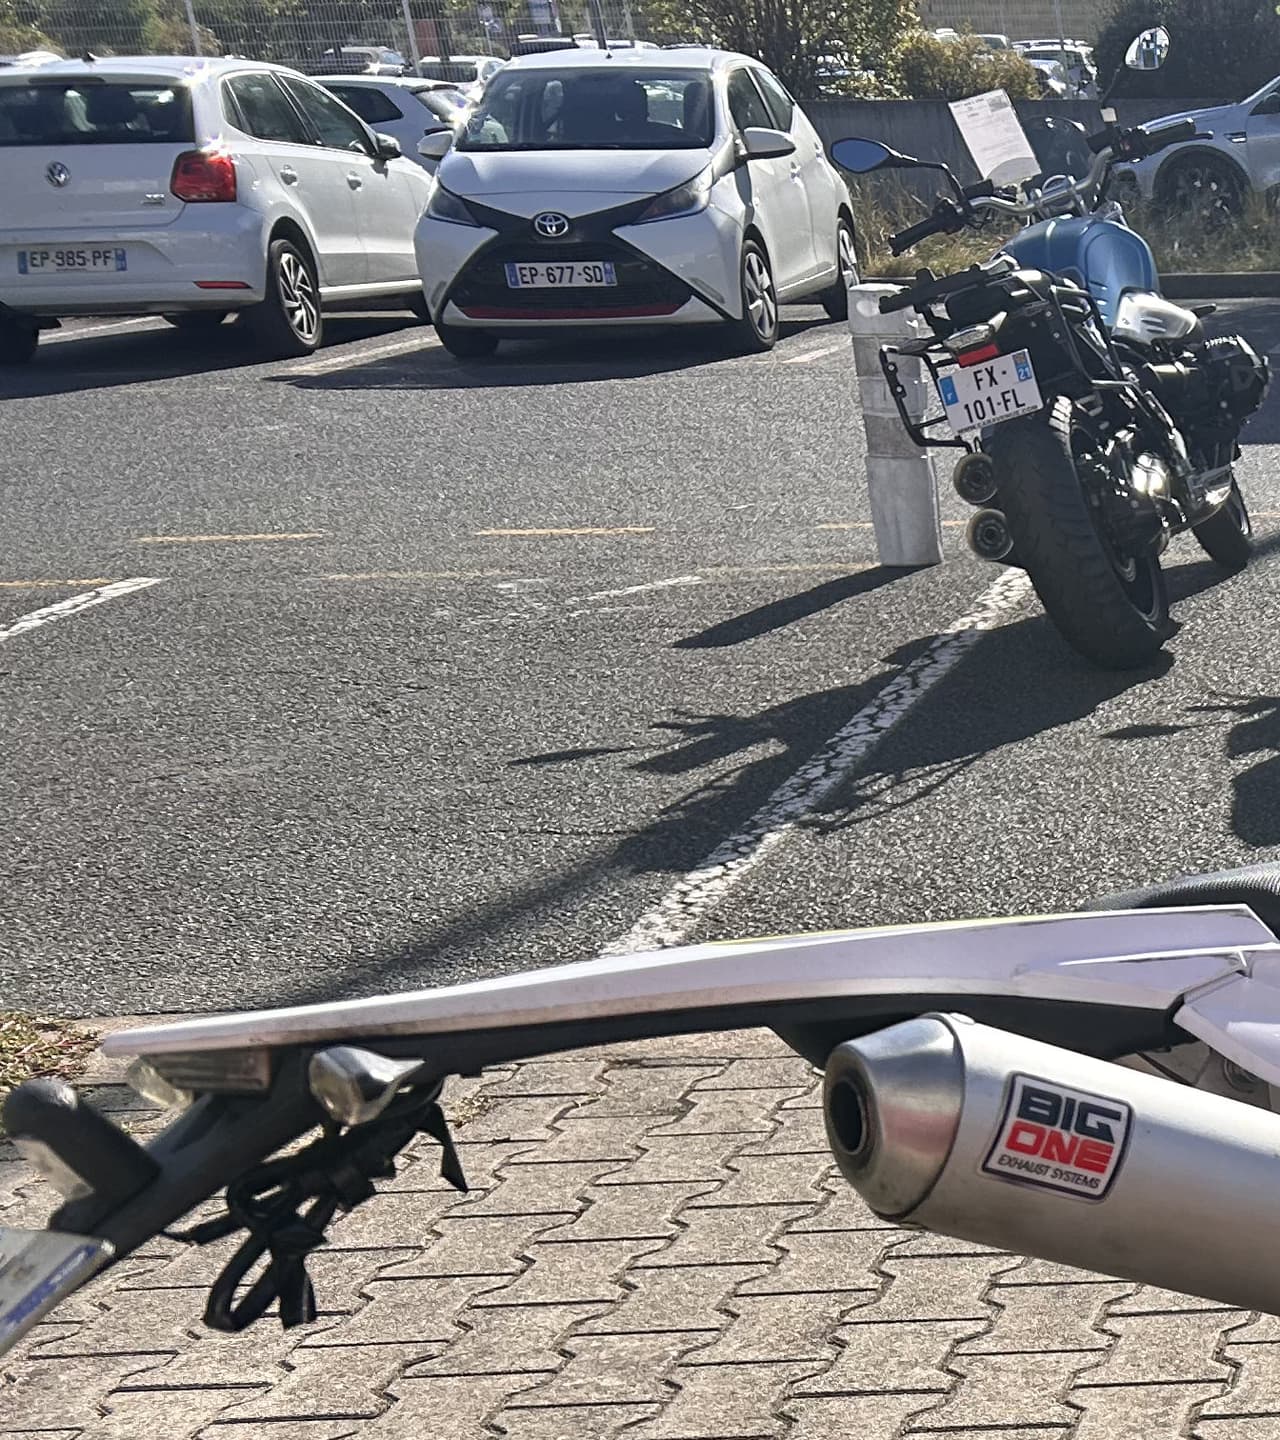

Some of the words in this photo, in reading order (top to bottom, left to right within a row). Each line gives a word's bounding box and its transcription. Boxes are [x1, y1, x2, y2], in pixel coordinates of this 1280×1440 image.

[518, 265, 603, 285] EP-677-SD
[1018, 366, 1032, 380] 21
[963, 388, 1026, 424] 101-FL
[1016, 1084, 1123, 1145] BIG
[1005, 1119, 1116, 1175] ONE
[998, 1153, 1051, 1177] EXHAUST
[1050, 1167, 1101, 1190] SYSTEMS
